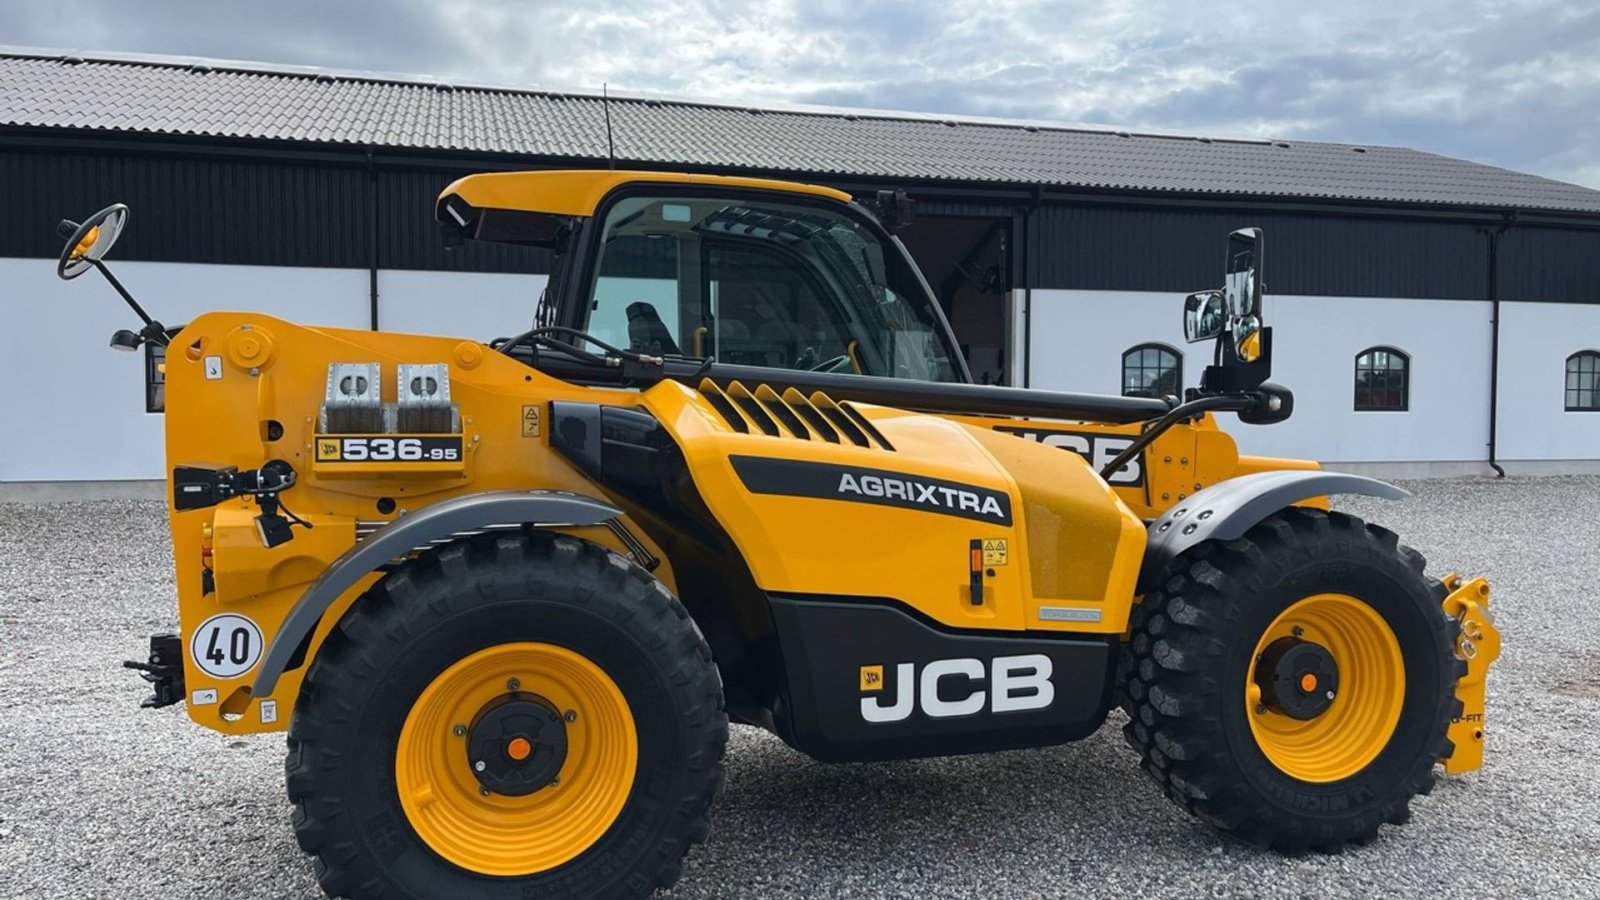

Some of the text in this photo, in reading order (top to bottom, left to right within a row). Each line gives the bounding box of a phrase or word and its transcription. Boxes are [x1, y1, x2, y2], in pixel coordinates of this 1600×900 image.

[343, 439, 457, 460] 536-95
[838, 473, 1005, 518] AGRIXTRA
[206, 627, 250, 665] 40
[860, 654, 1055, 723] JCB
